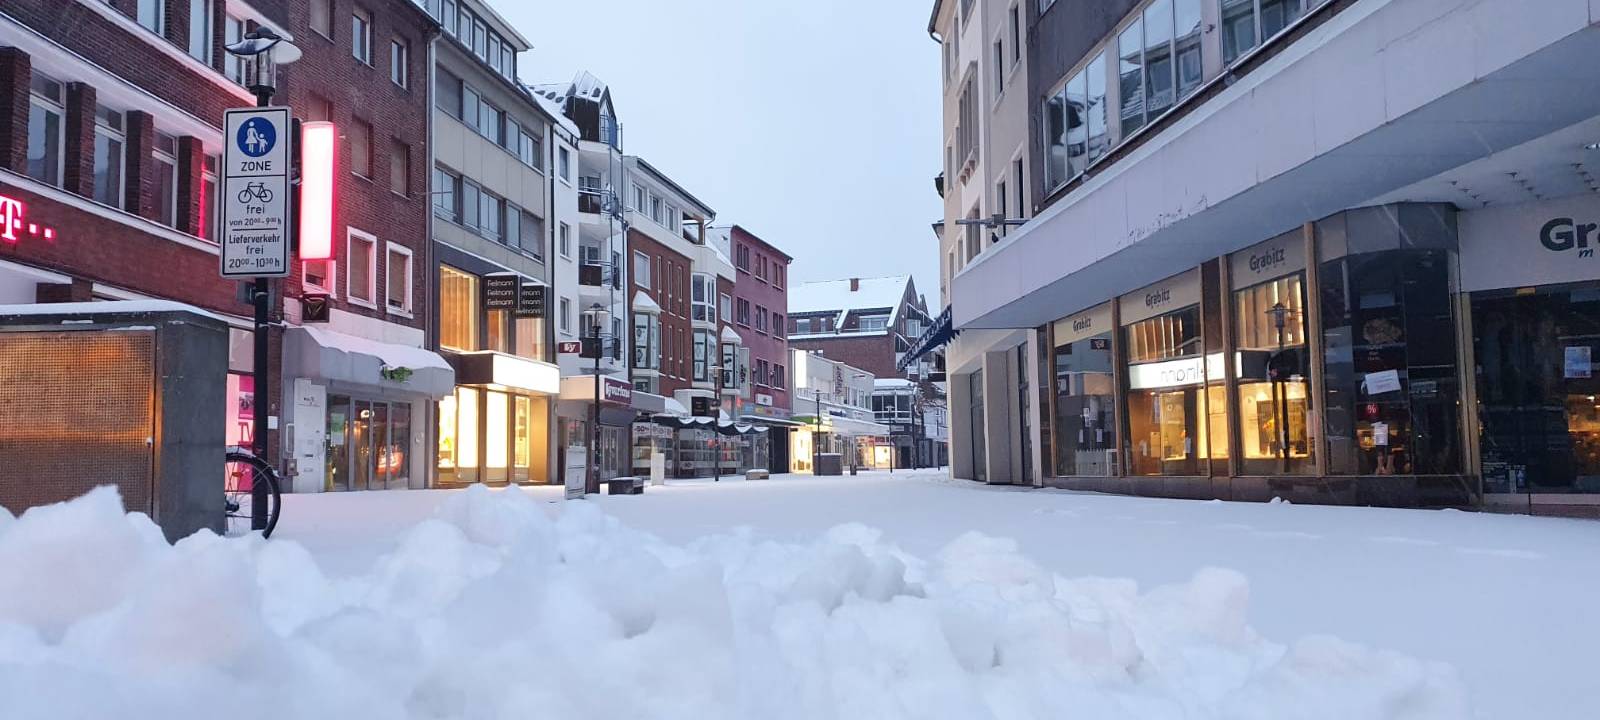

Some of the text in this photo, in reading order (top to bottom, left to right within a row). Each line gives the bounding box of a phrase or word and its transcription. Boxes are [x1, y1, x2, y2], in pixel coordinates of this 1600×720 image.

[240, 160, 272, 172] ZONE
[246, 204, 265, 214] frei
[229, 233, 281, 244] Lieferverkehr
[1540, 217, 1600, 251] Gr
[245, 245, 264, 254] frei
[274, 258, 280, 267] h
[1249, 248, 1285, 273] Grabitz
[1145, 288, 1170, 307] Grabitz
[1072, 316, 1091, 333] Grabitz
